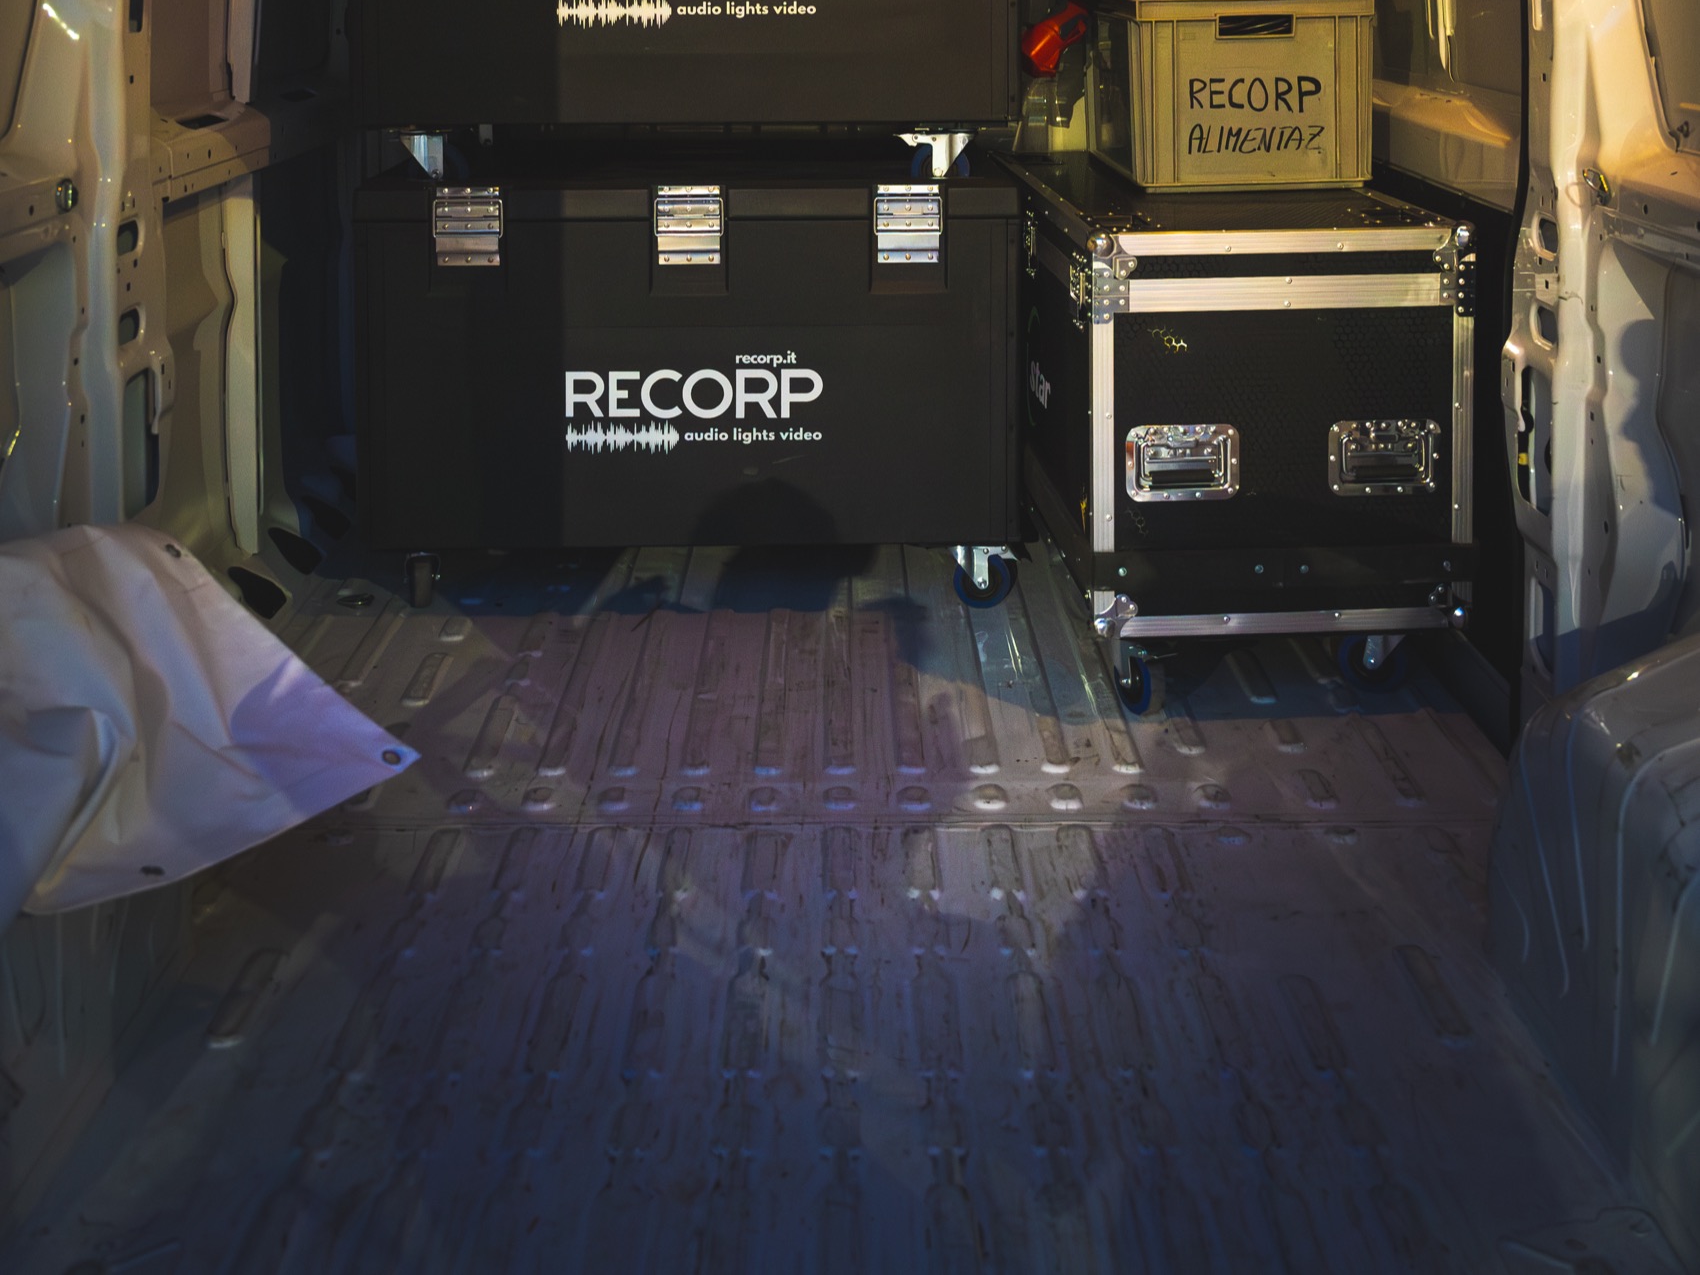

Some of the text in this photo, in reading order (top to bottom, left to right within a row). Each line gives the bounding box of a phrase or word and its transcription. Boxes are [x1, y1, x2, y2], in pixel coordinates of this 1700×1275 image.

[676, 0, 817, 19] audio lights video
[1188, 75, 1322, 114] RECORP
[735, 350, 797, 368] recorp.it
[565, 368, 824, 420] RECORP
[684, 426, 823, 445] audio lights video
